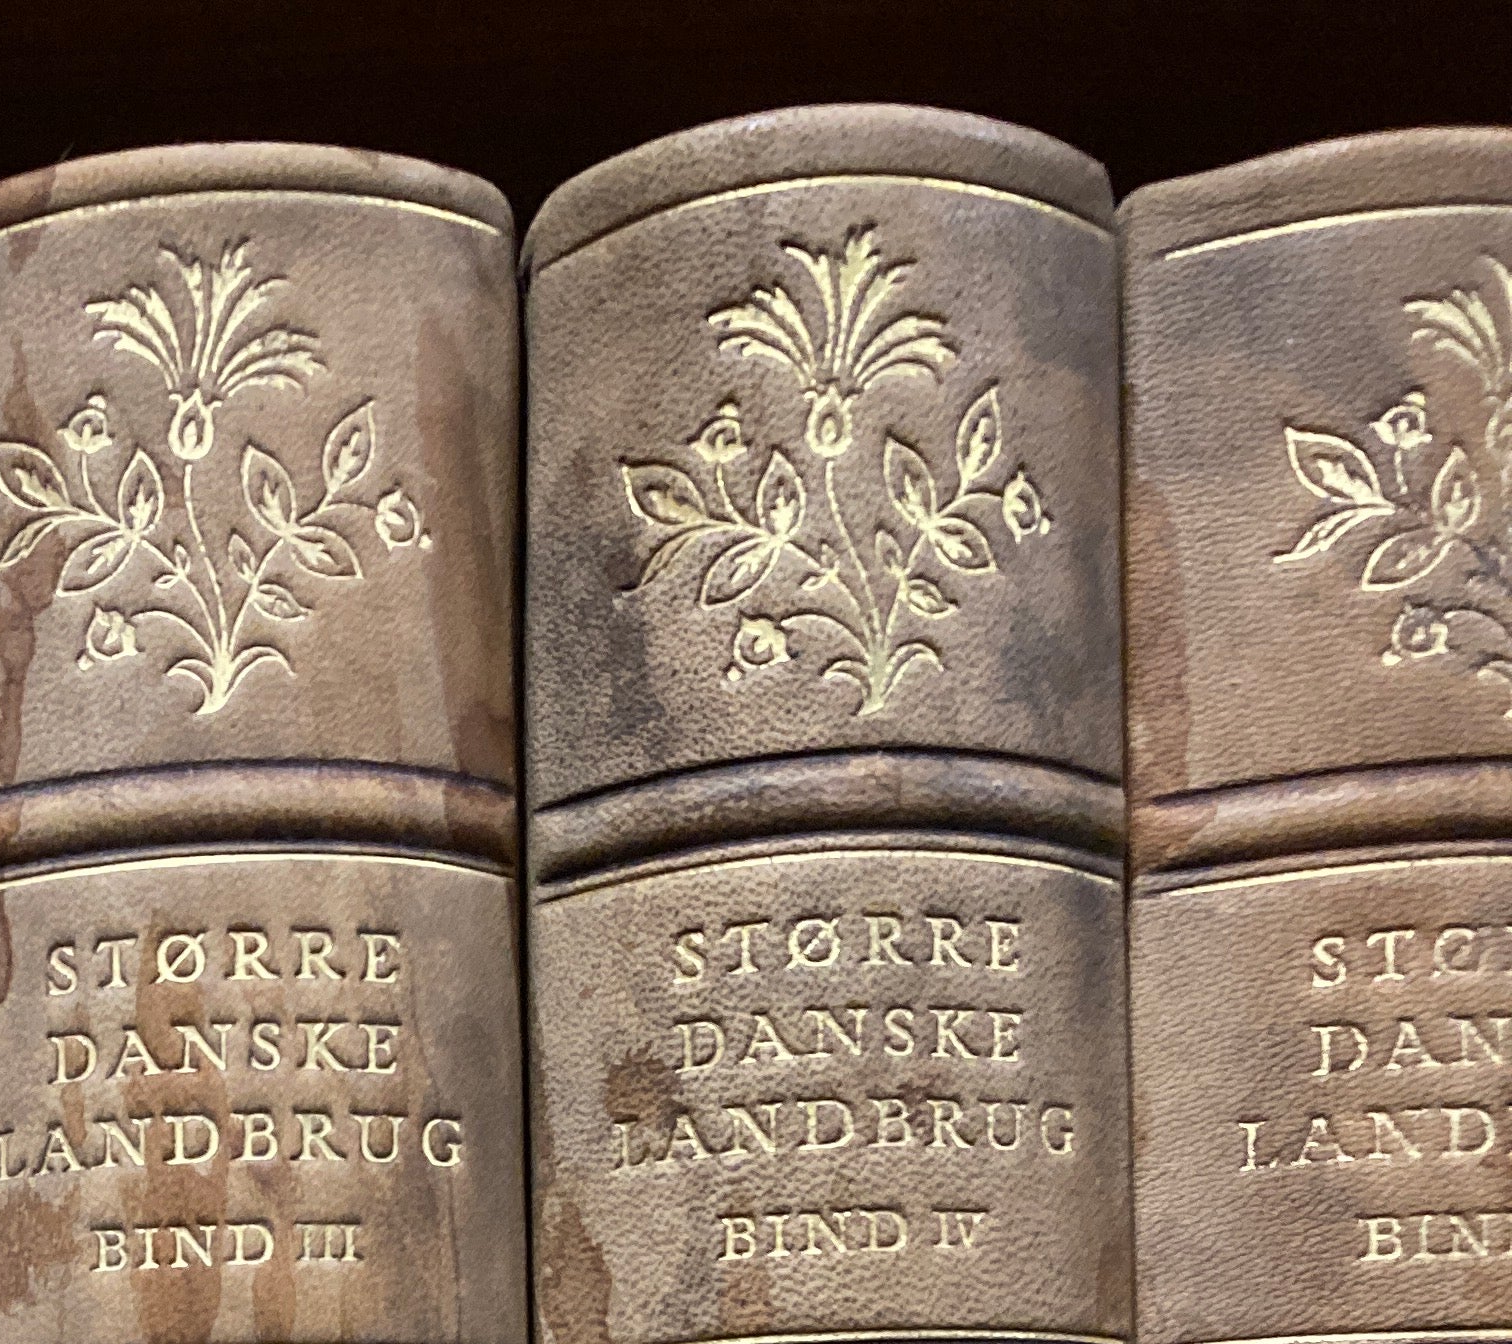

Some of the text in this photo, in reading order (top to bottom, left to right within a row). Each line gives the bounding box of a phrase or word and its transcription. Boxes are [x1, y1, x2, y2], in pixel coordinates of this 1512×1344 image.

[48, 928, 402, 996] STØRRE
[672, 915, 1021, 984] STØRRE
[1312, 926, 1512, 988] STØ
[48, 1018, 402, 1085] DANSKE
[673, 1007, 1022, 1073] DANSKE
[610, 1099, 1075, 1172] LANDBRUG
[1238, 1106, 1512, 1172] LAND
[90, 1222, 363, 1273] BIND III
[719, 1208, 988, 1261] BIND IV
[1356, 1213, 1512, 1262] BIN
